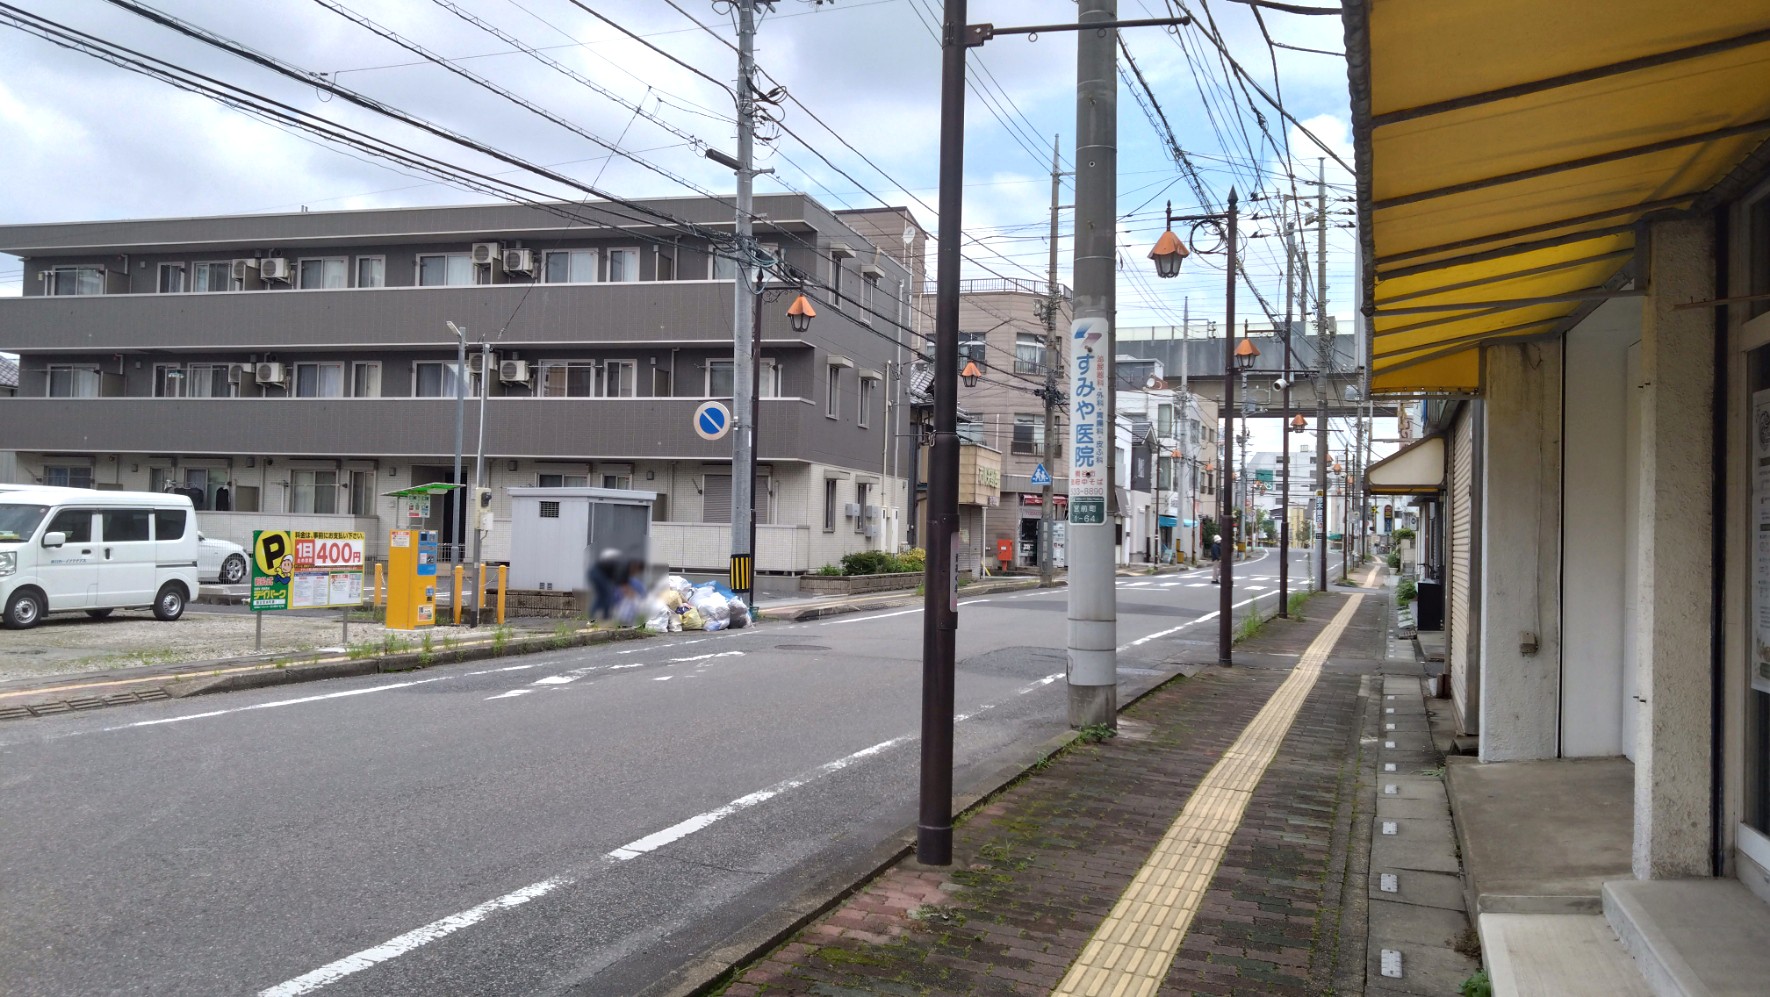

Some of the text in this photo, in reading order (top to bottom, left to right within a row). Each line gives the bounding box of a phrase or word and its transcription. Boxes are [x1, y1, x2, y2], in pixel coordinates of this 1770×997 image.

[1075, 353, 1095, 468] すみや医院
[262, 534, 286, 570] P
[296, 542, 313, 558] 1日
[317, 542, 361, 564] 400円
[254, 589, 287, 600] デイパーク
